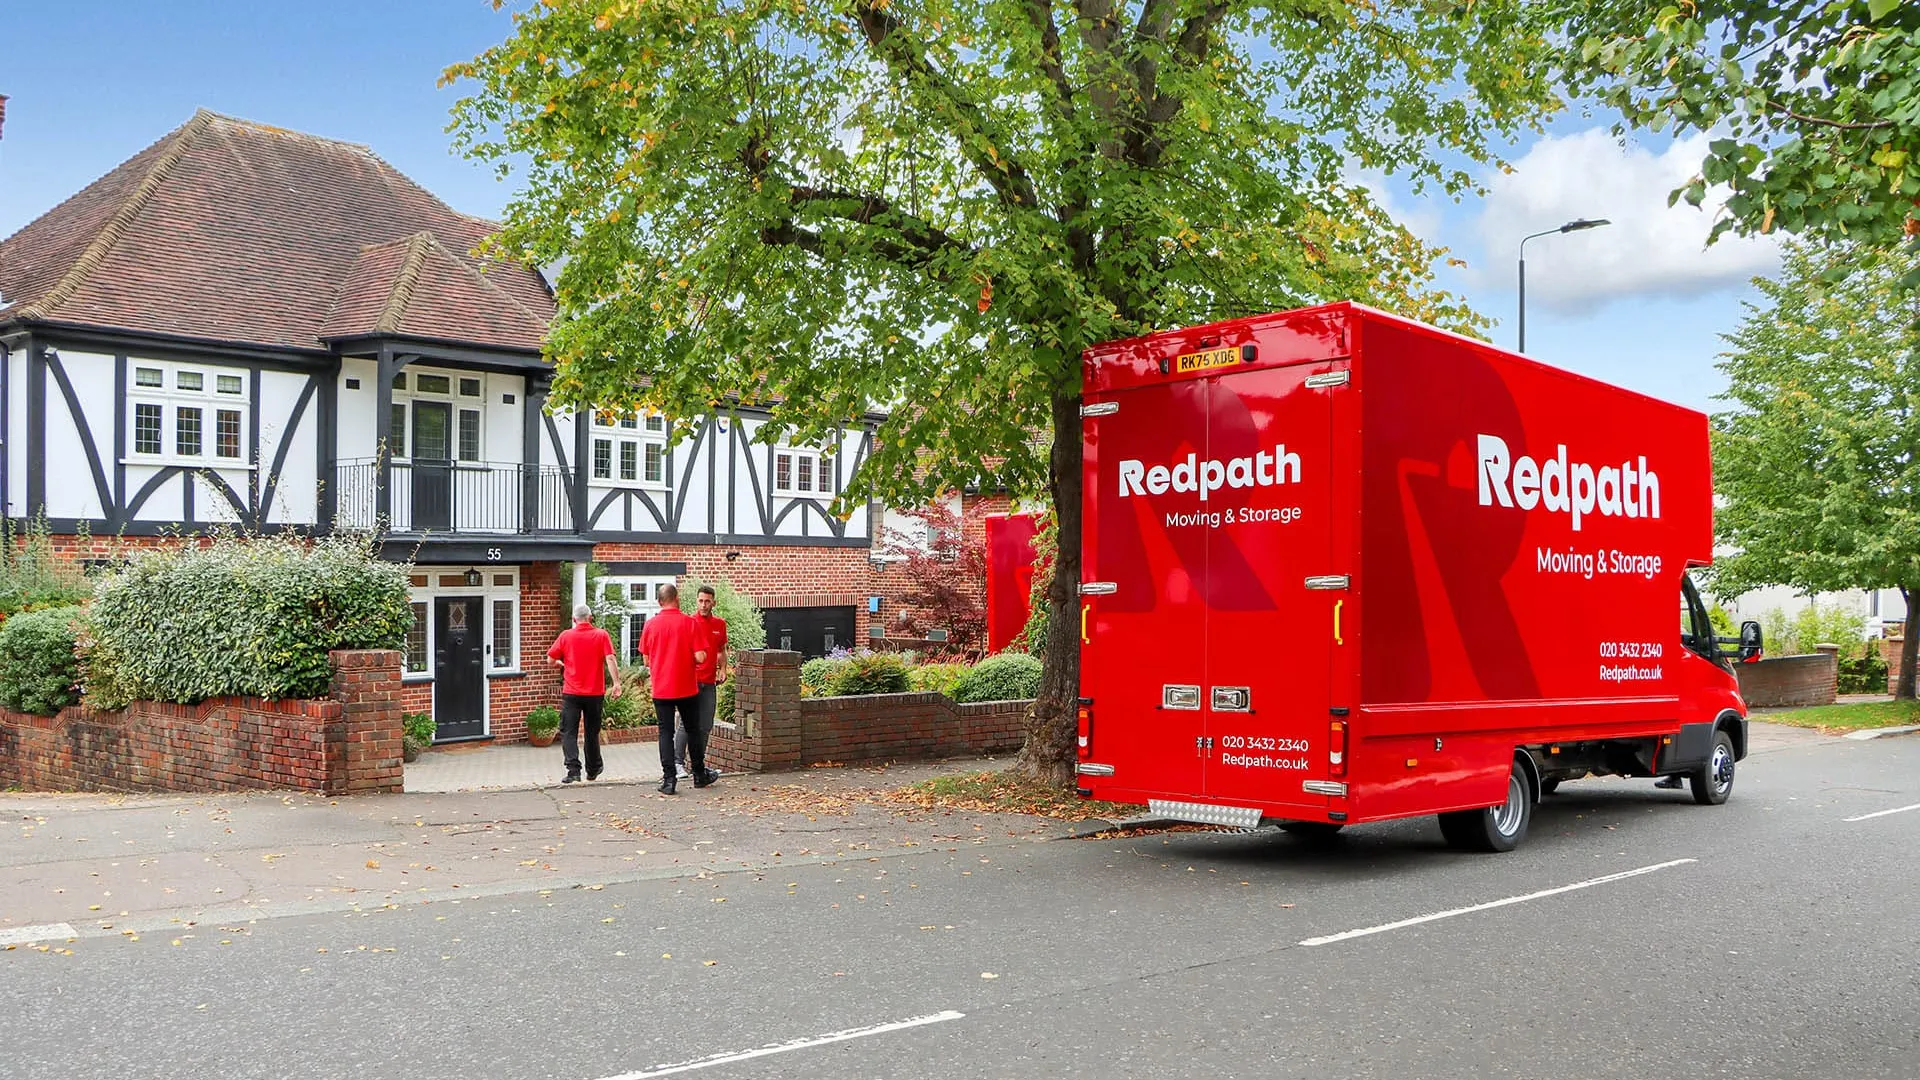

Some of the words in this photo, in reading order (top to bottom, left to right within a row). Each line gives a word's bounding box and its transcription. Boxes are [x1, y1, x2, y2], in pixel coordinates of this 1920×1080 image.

[1181, 354, 1210, 370] RK75
[1213, 350, 1235, 365] XDG
[1118, 444, 1301, 501] Redpath
[1477, 433, 1660, 531] Redpath
[1166, 510, 1221, 528] Moving
[1224, 508, 1236, 524] &
[1239, 507, 1302, 524] Storage
[487, 548, 502, 560] 55
[1537, 546, 1593, 580] Moving
[1596, 549, 1608, 574] &
[1610, 549, 1662, 580] Storage
[1600, 642, 1618, 658] 020
[1618, 642, 1640, 658] 3432
[1641, 642, 1663, 658] 2340
[1599, 664, 1663, 684] Redpath.co.uk
[1222, 736, 1245, 749] 020
[1247, 736, 1276, 751] 3432
[1278, 738, 1309, 753] 2340
[1222, 753, 1309, 770] Redpath.co.uk
